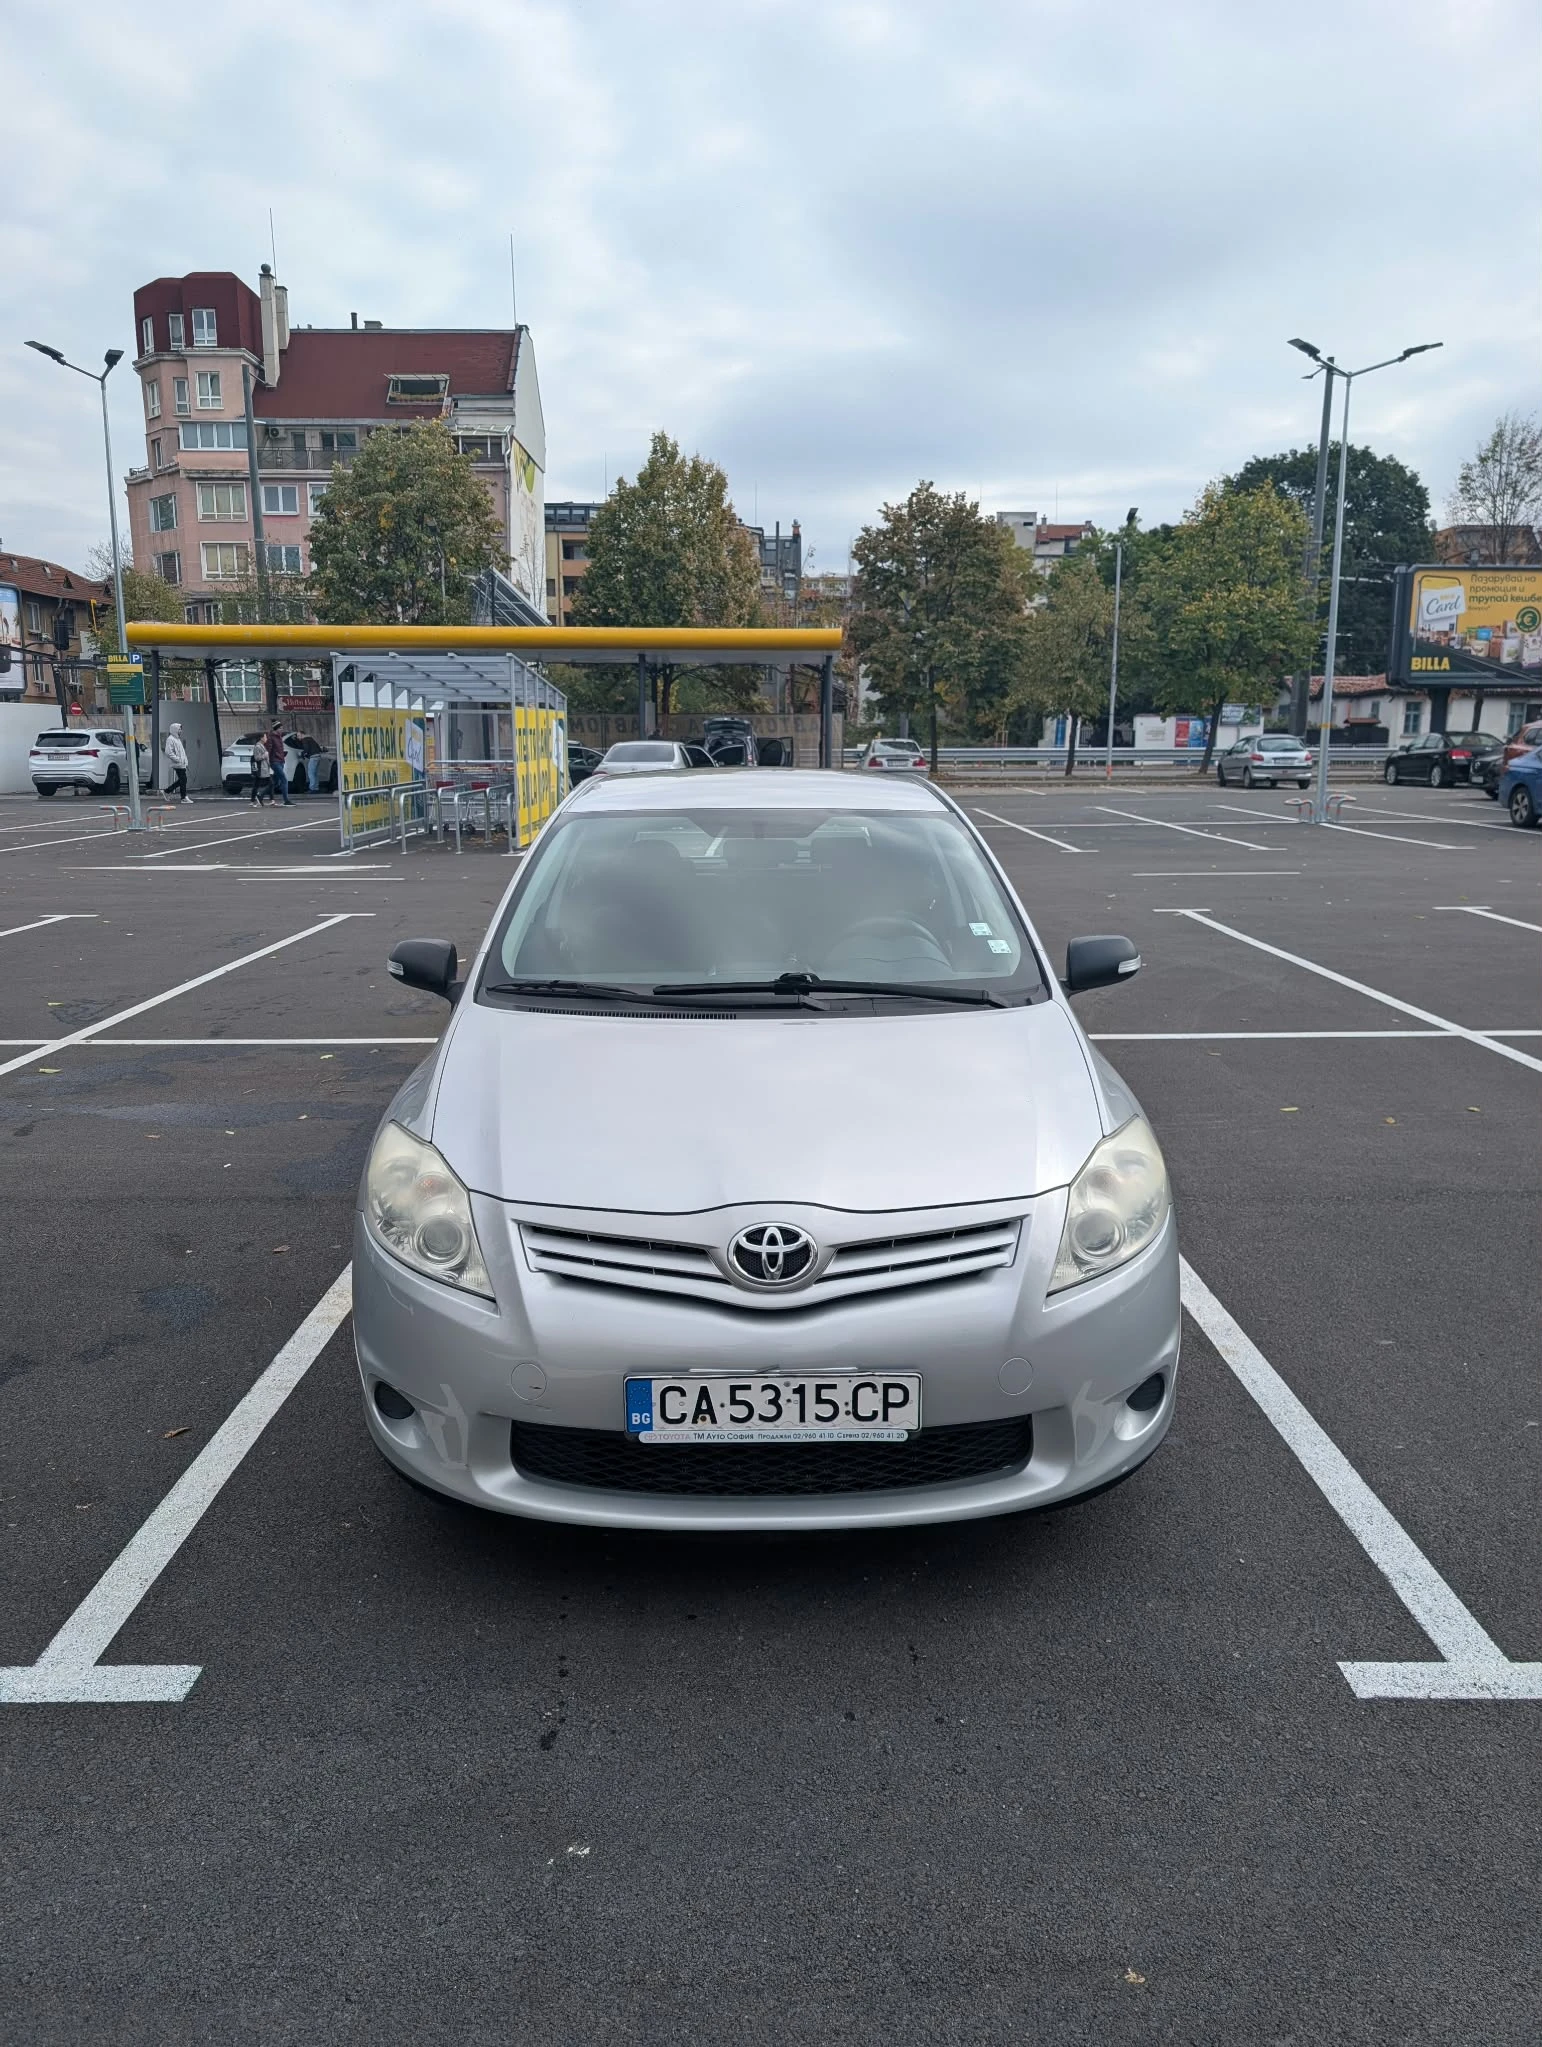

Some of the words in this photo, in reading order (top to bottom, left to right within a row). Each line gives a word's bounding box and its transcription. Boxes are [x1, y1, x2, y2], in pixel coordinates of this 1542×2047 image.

[1470, 574, 1522, 584] Пазарувай
[1469, 586, 1517, 594] промоция
[1426, 595, 1461, 616] Card
[1468, 594, 1508, 605] трупай
[108, 655, 128, 663] BILLA
[132, 654, 140, 663] P
[1411, 656, 1450, 671] BILLA
[342, 719, 397, 762] СПЕСТЯВАЙ
[659, 1385, 718, 1424] CA
[729, 1383, 840, 1423] 5315
[852, 1381, 910, 1422] CP
[632, 1412, 651, 1424] BG
